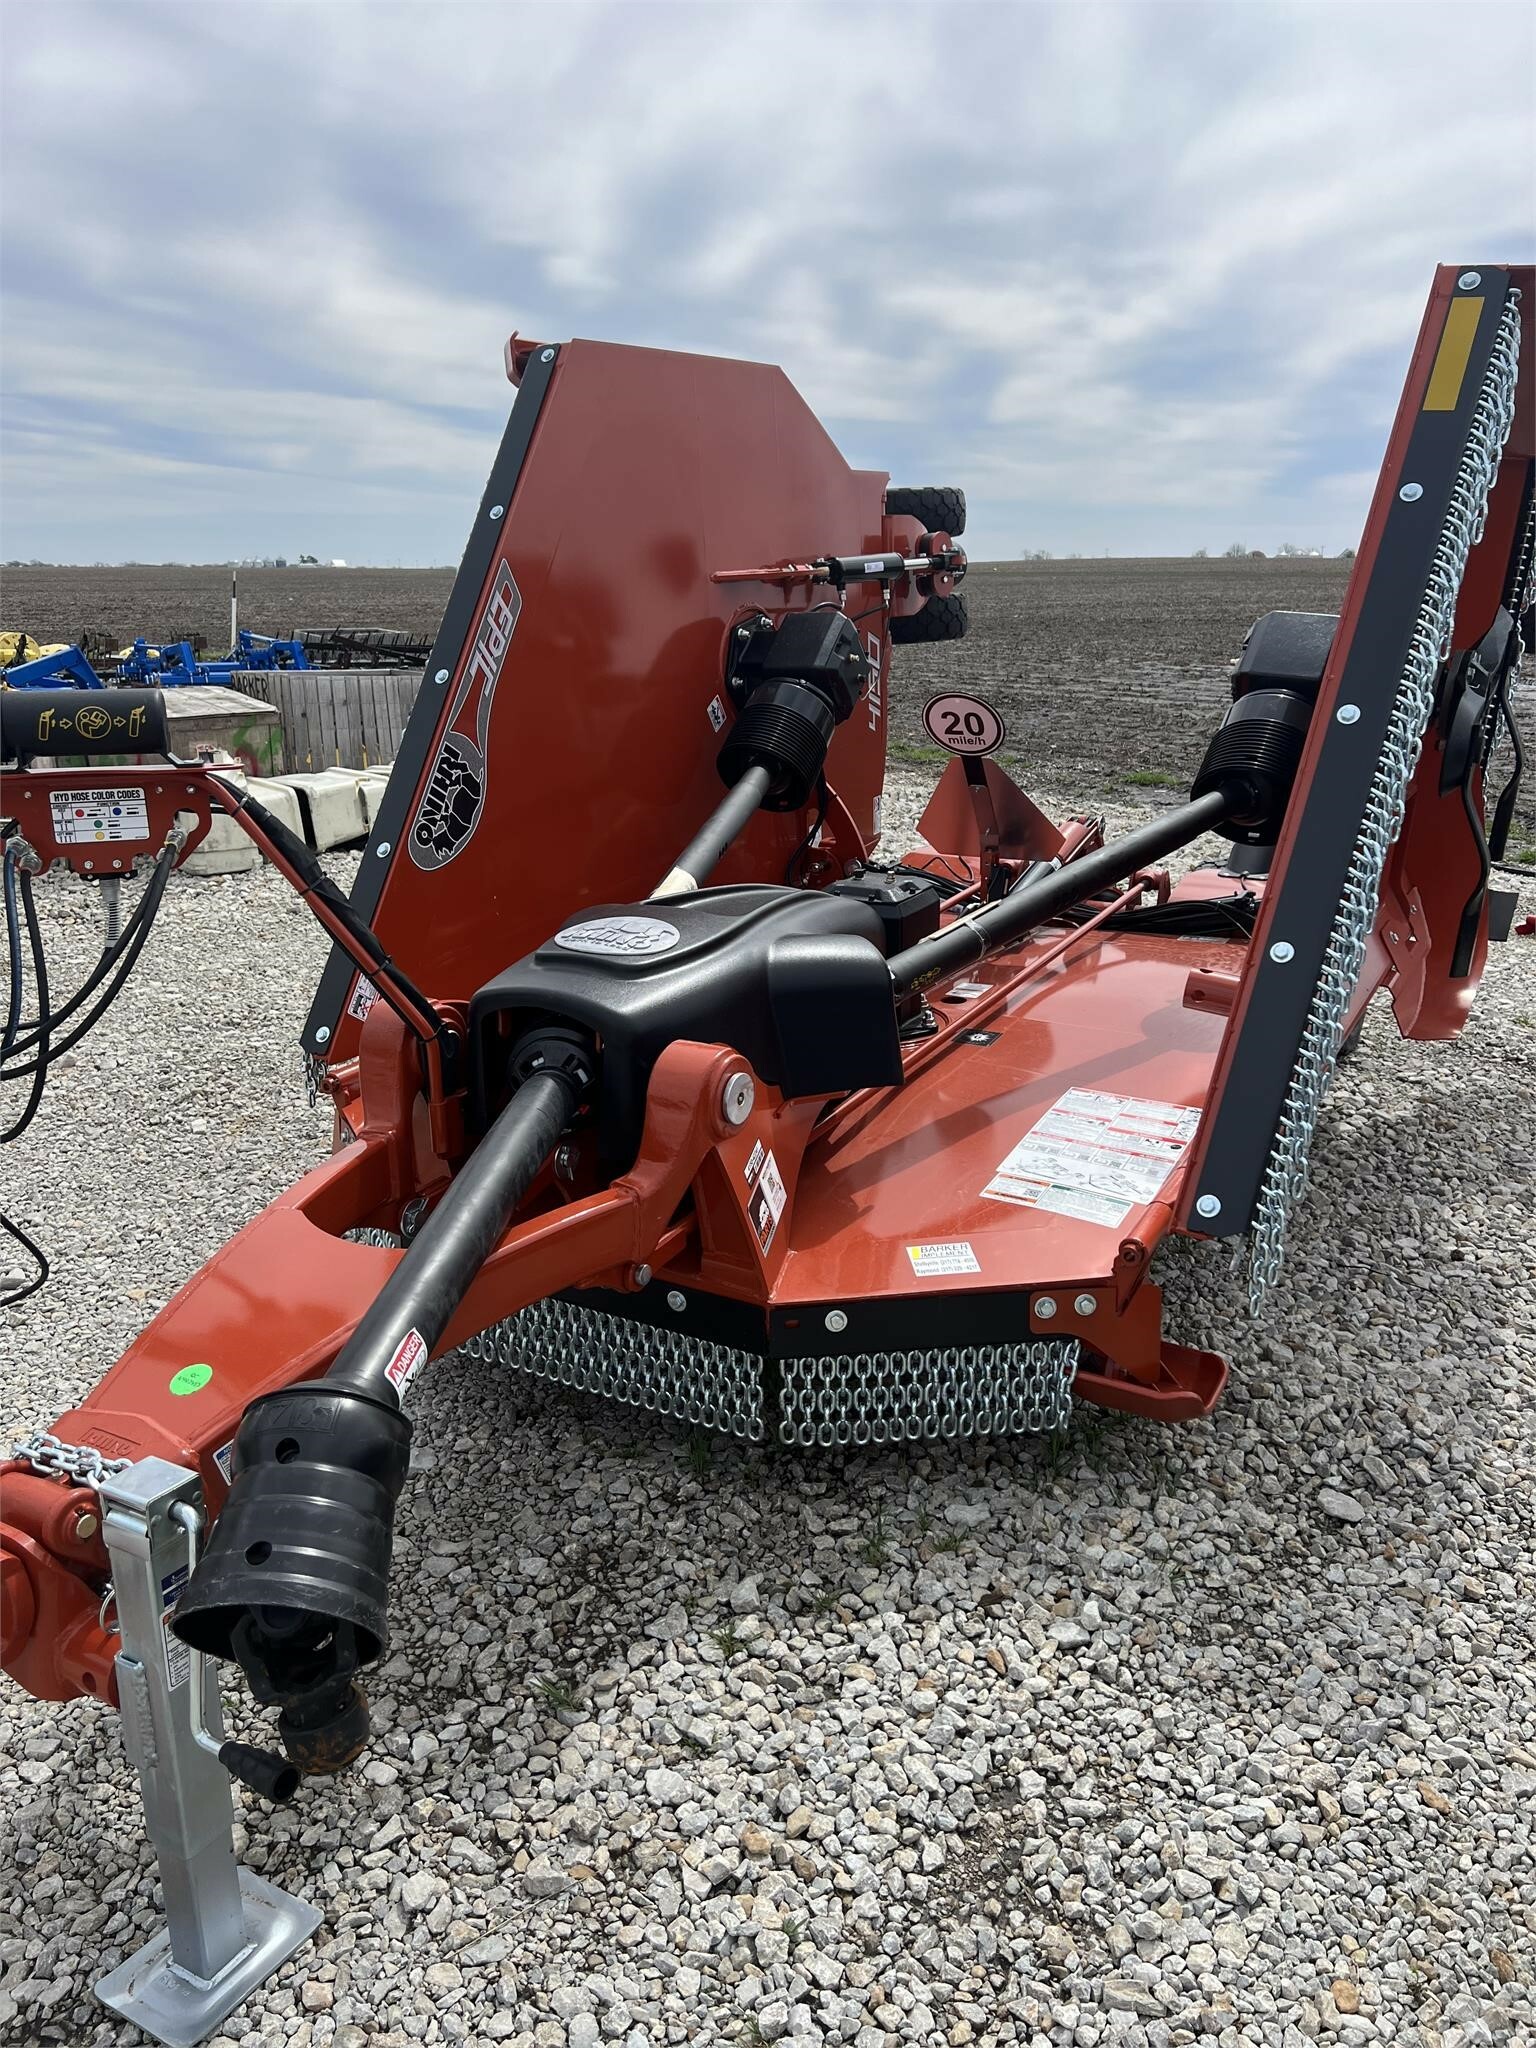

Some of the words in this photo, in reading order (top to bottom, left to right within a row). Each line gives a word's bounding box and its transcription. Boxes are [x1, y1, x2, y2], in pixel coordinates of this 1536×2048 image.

[469, 590, 513, 697] EPIC
[941, 711, 985, 736] 20
[948, 735, 986, 746] mile/h
[54, 793, 70, 802] HYD
[71, 792, 90, 801] HOSE
[92, 791, 116, 800] COLOR
[117, 790, 140, 799] CODES
[415, 741, 465, 848] RHINO
[920, 1244, 968, 1253] BARKER
[396, 1334, 422, 1372] DANGER
